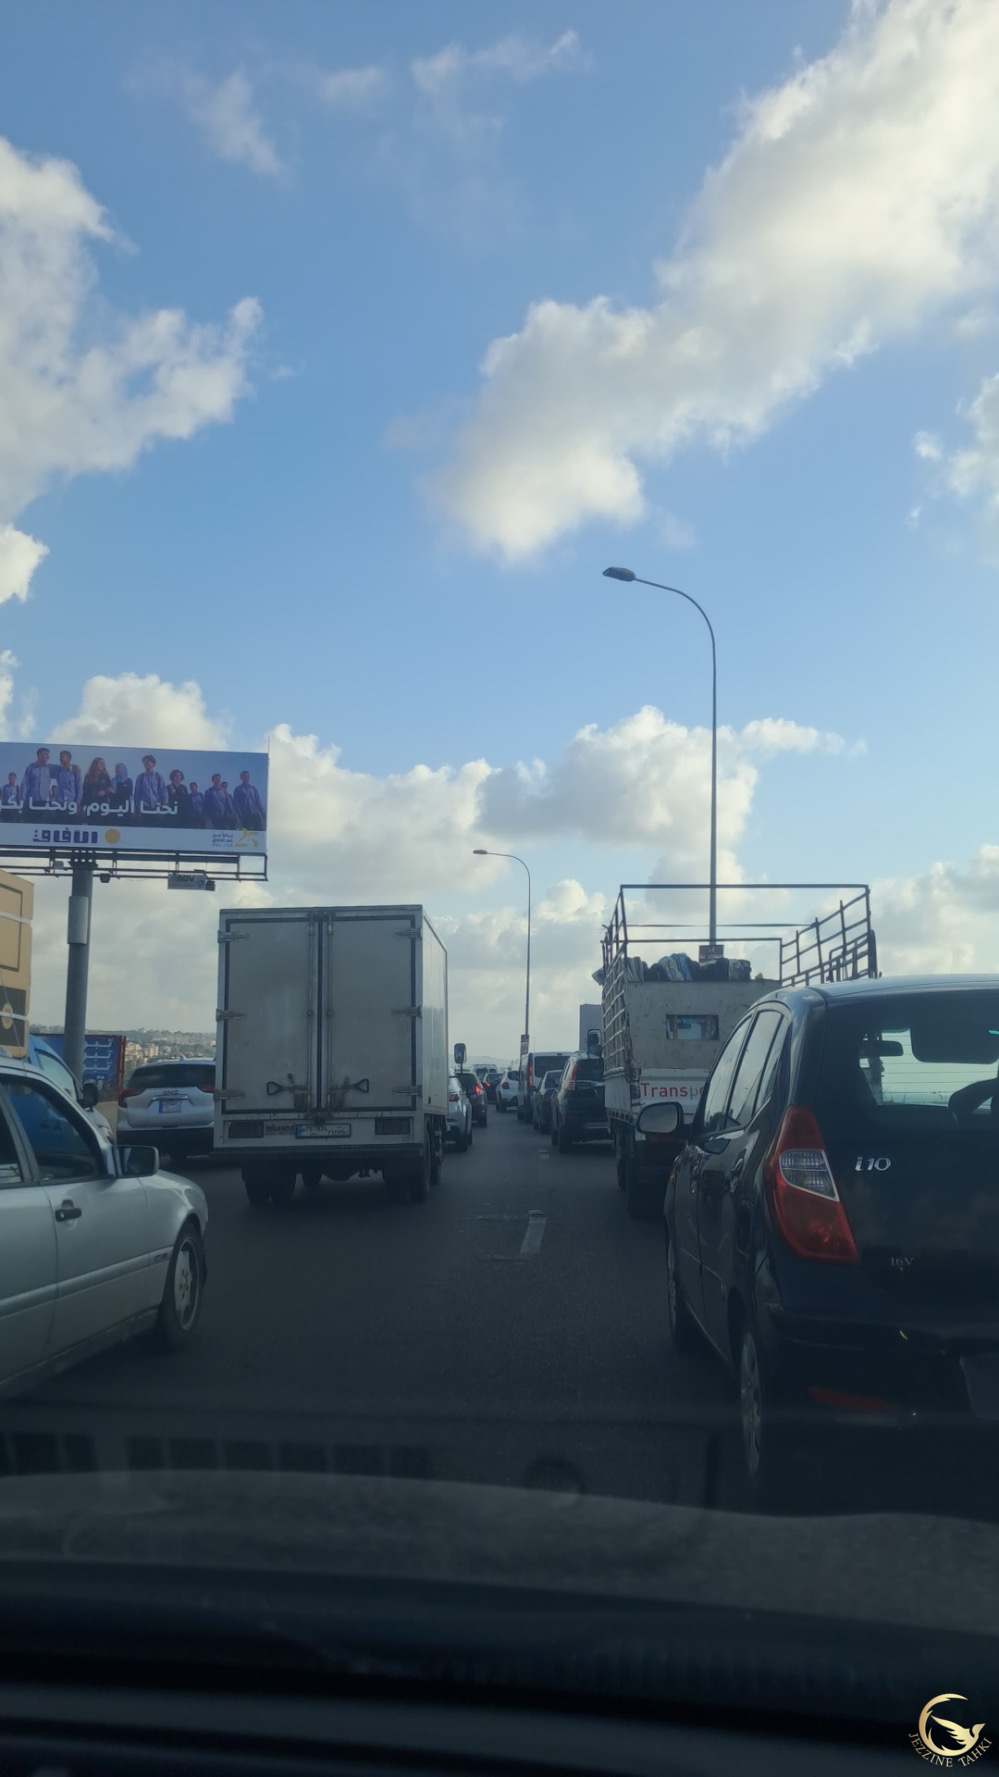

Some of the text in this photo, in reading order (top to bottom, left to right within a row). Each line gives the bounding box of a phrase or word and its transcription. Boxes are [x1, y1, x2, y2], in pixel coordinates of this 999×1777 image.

[29, 796, 78, 815] ونحنا
[140, 800, 179, 815] نحنا
[855, 1156, 892, 1172] i10
